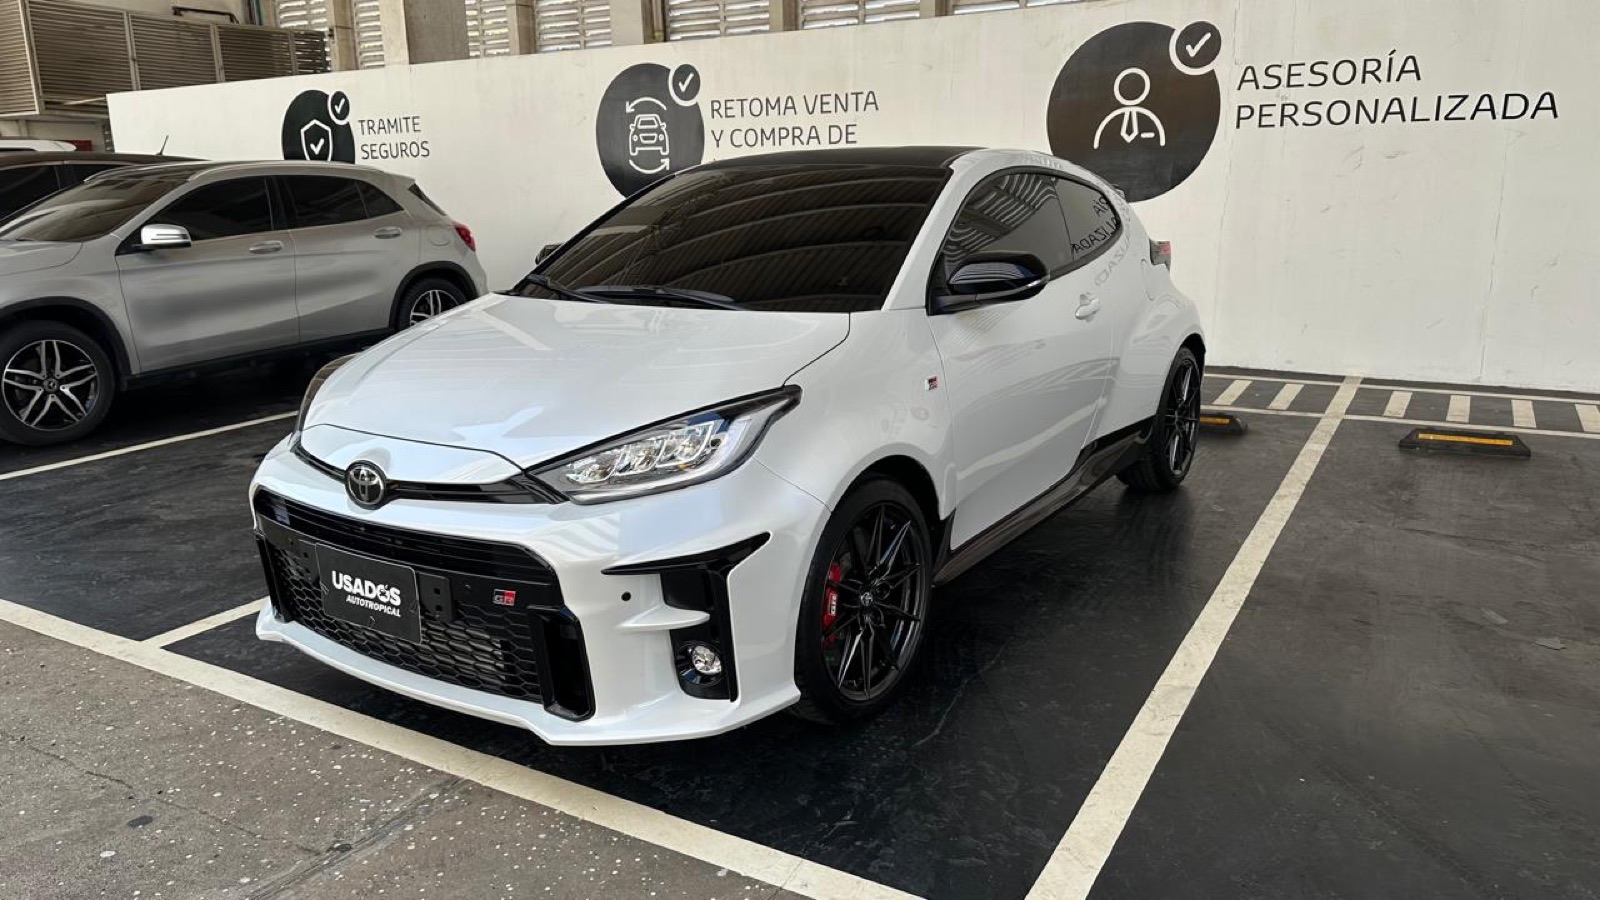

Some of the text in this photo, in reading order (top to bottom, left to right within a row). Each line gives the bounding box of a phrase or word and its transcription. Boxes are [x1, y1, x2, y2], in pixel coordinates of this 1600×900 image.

[1237, 50, 1422, 91] ASESORÍA
[710, 90, 879, 119] RETOMA VENTA
[1235, 91, 1559, 129] PERSONALIZADA
[357, 115, 421, 135] TRAMITE
[710, 123, 858, 148] Y COMPRA DE
[360, 140, 430, 160] SEGUROS
[331, 570, 401, 606] USADOS
[345, 594, 401, 617] AUTOTROPICAL
